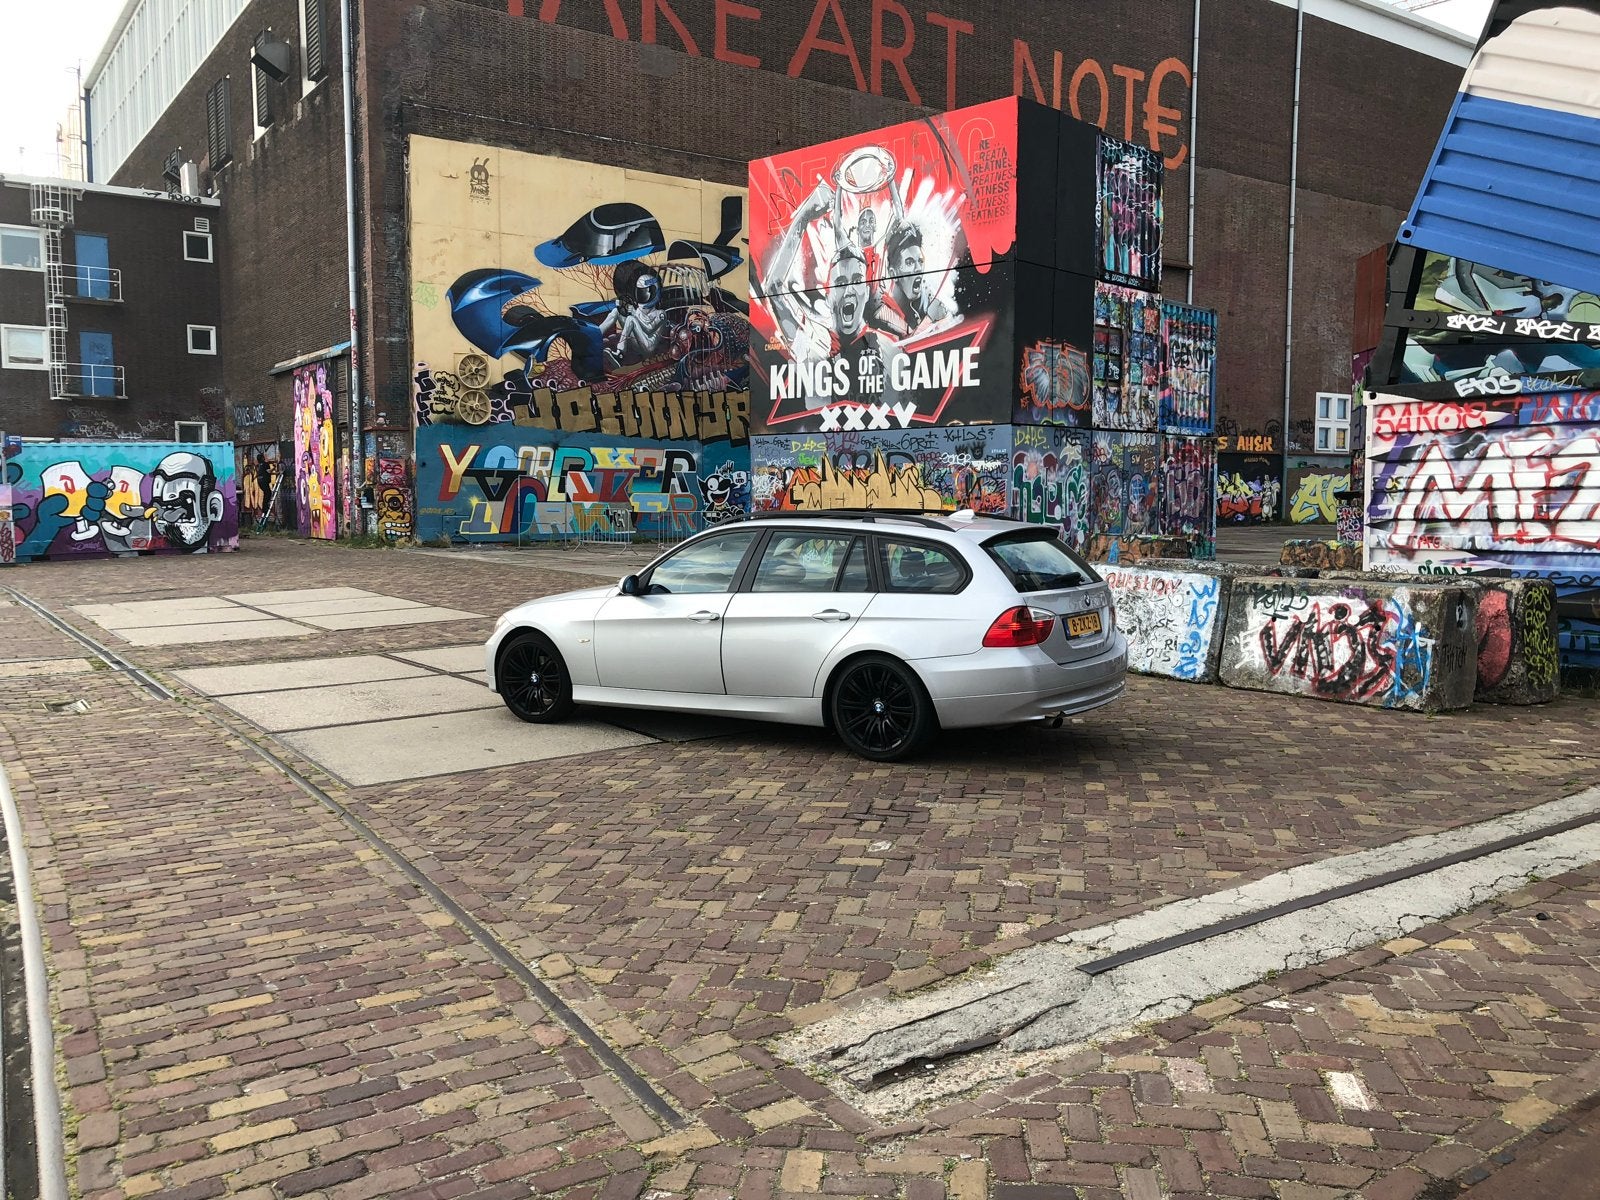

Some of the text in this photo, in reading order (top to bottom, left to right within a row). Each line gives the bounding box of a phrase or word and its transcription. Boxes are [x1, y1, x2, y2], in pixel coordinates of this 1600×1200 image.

[787, 0, 974, 113] ART
[770, 346, 980, 400] KINGS OF THE GAME
[819, 401, 917, 432] XXXV
